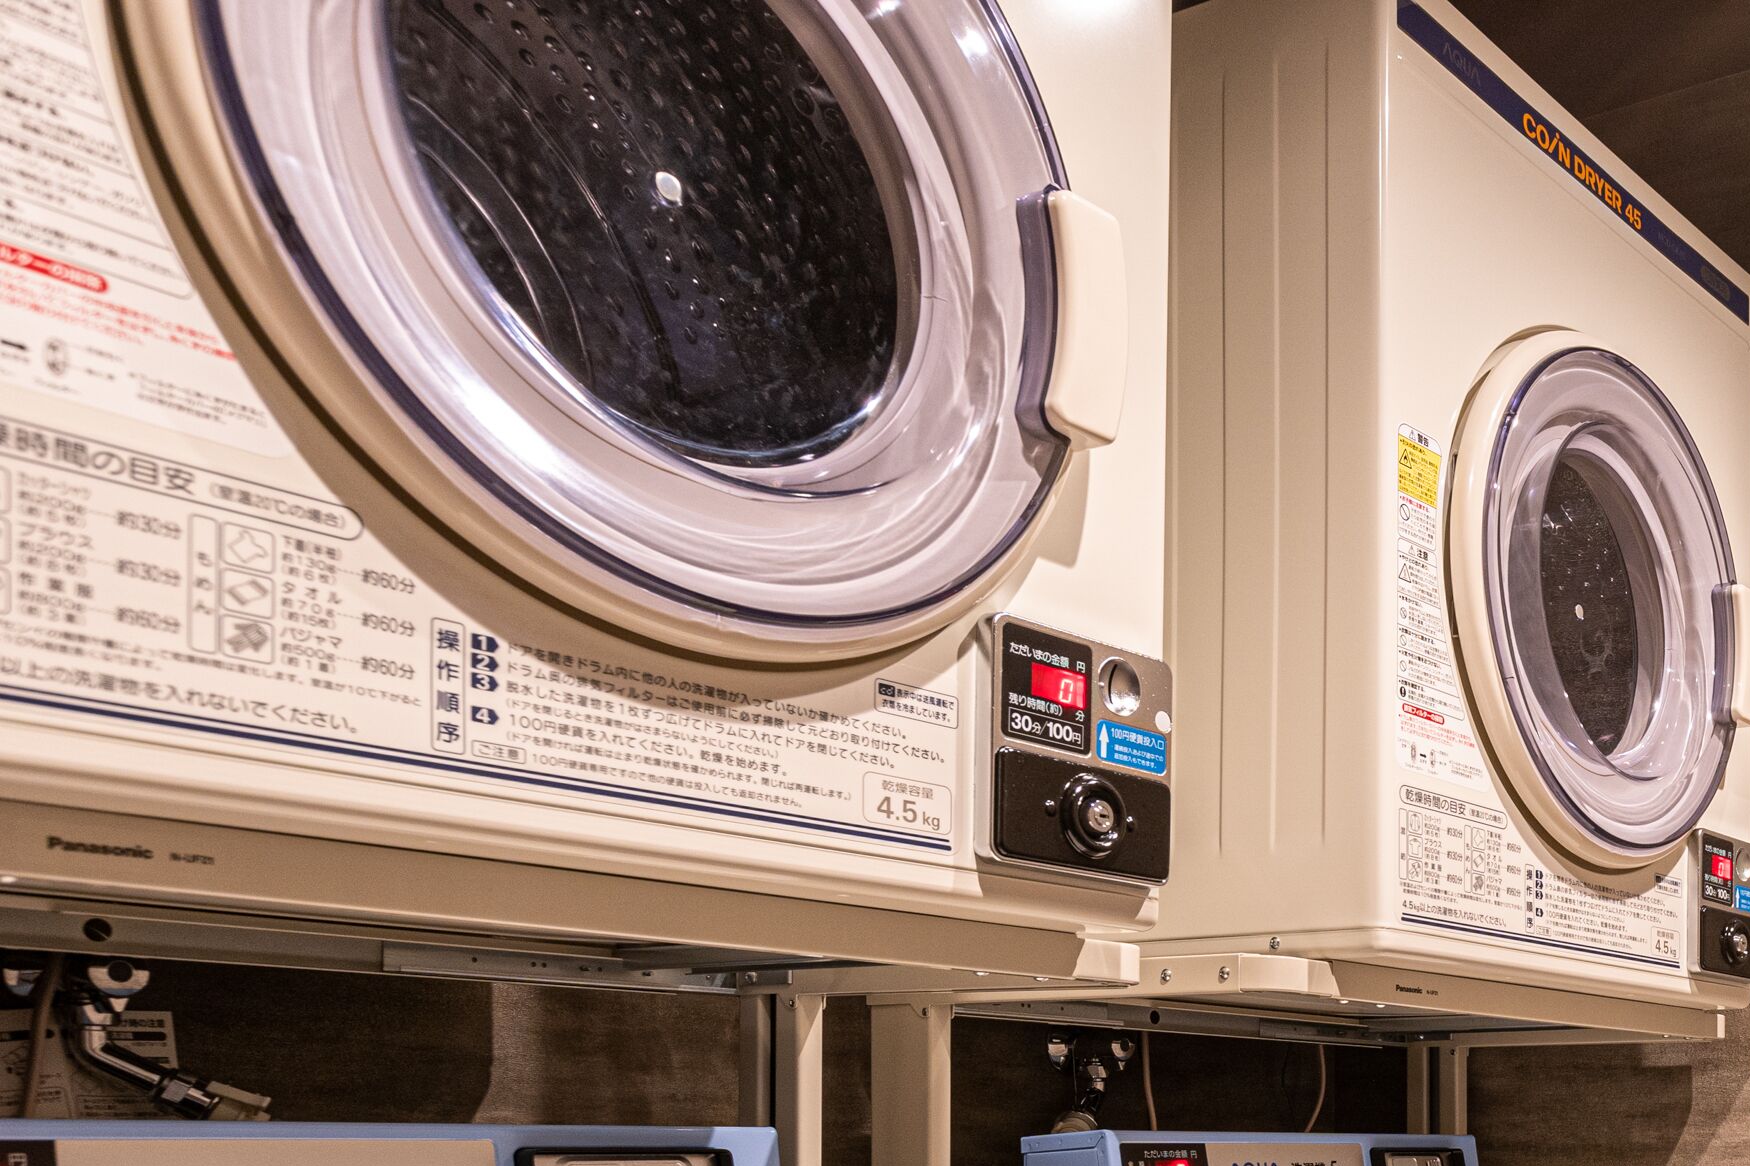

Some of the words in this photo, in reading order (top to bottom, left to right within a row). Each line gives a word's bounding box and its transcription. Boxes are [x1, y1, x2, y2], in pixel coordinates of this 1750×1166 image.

[1574, 154, 1622, 214] DRYER
[1625, 204, 1642, 230] 45
[1009, 642, 1070, 668] ただいまの金額
[1076, 661, 1086, 673] 円
[436, 628, 460, 744] 操作順序
[1059, 679, 1073, 703] 0
[1075, 711, 1085, 722] 分
[478, 744, 520, 761] ご注意
[881, 780, 934, 800] 乾燥容量
[876, 796, 918, 823] 4.5
[922, 811, 941, 830] kg
[1405, 788, 1466, 816] 乾燥時間の目安
[1655, 940, 1669, 954] 4.5
[8, 1152, 28, 1166] 円
[1190, 1150, 1197, 1158] 円
